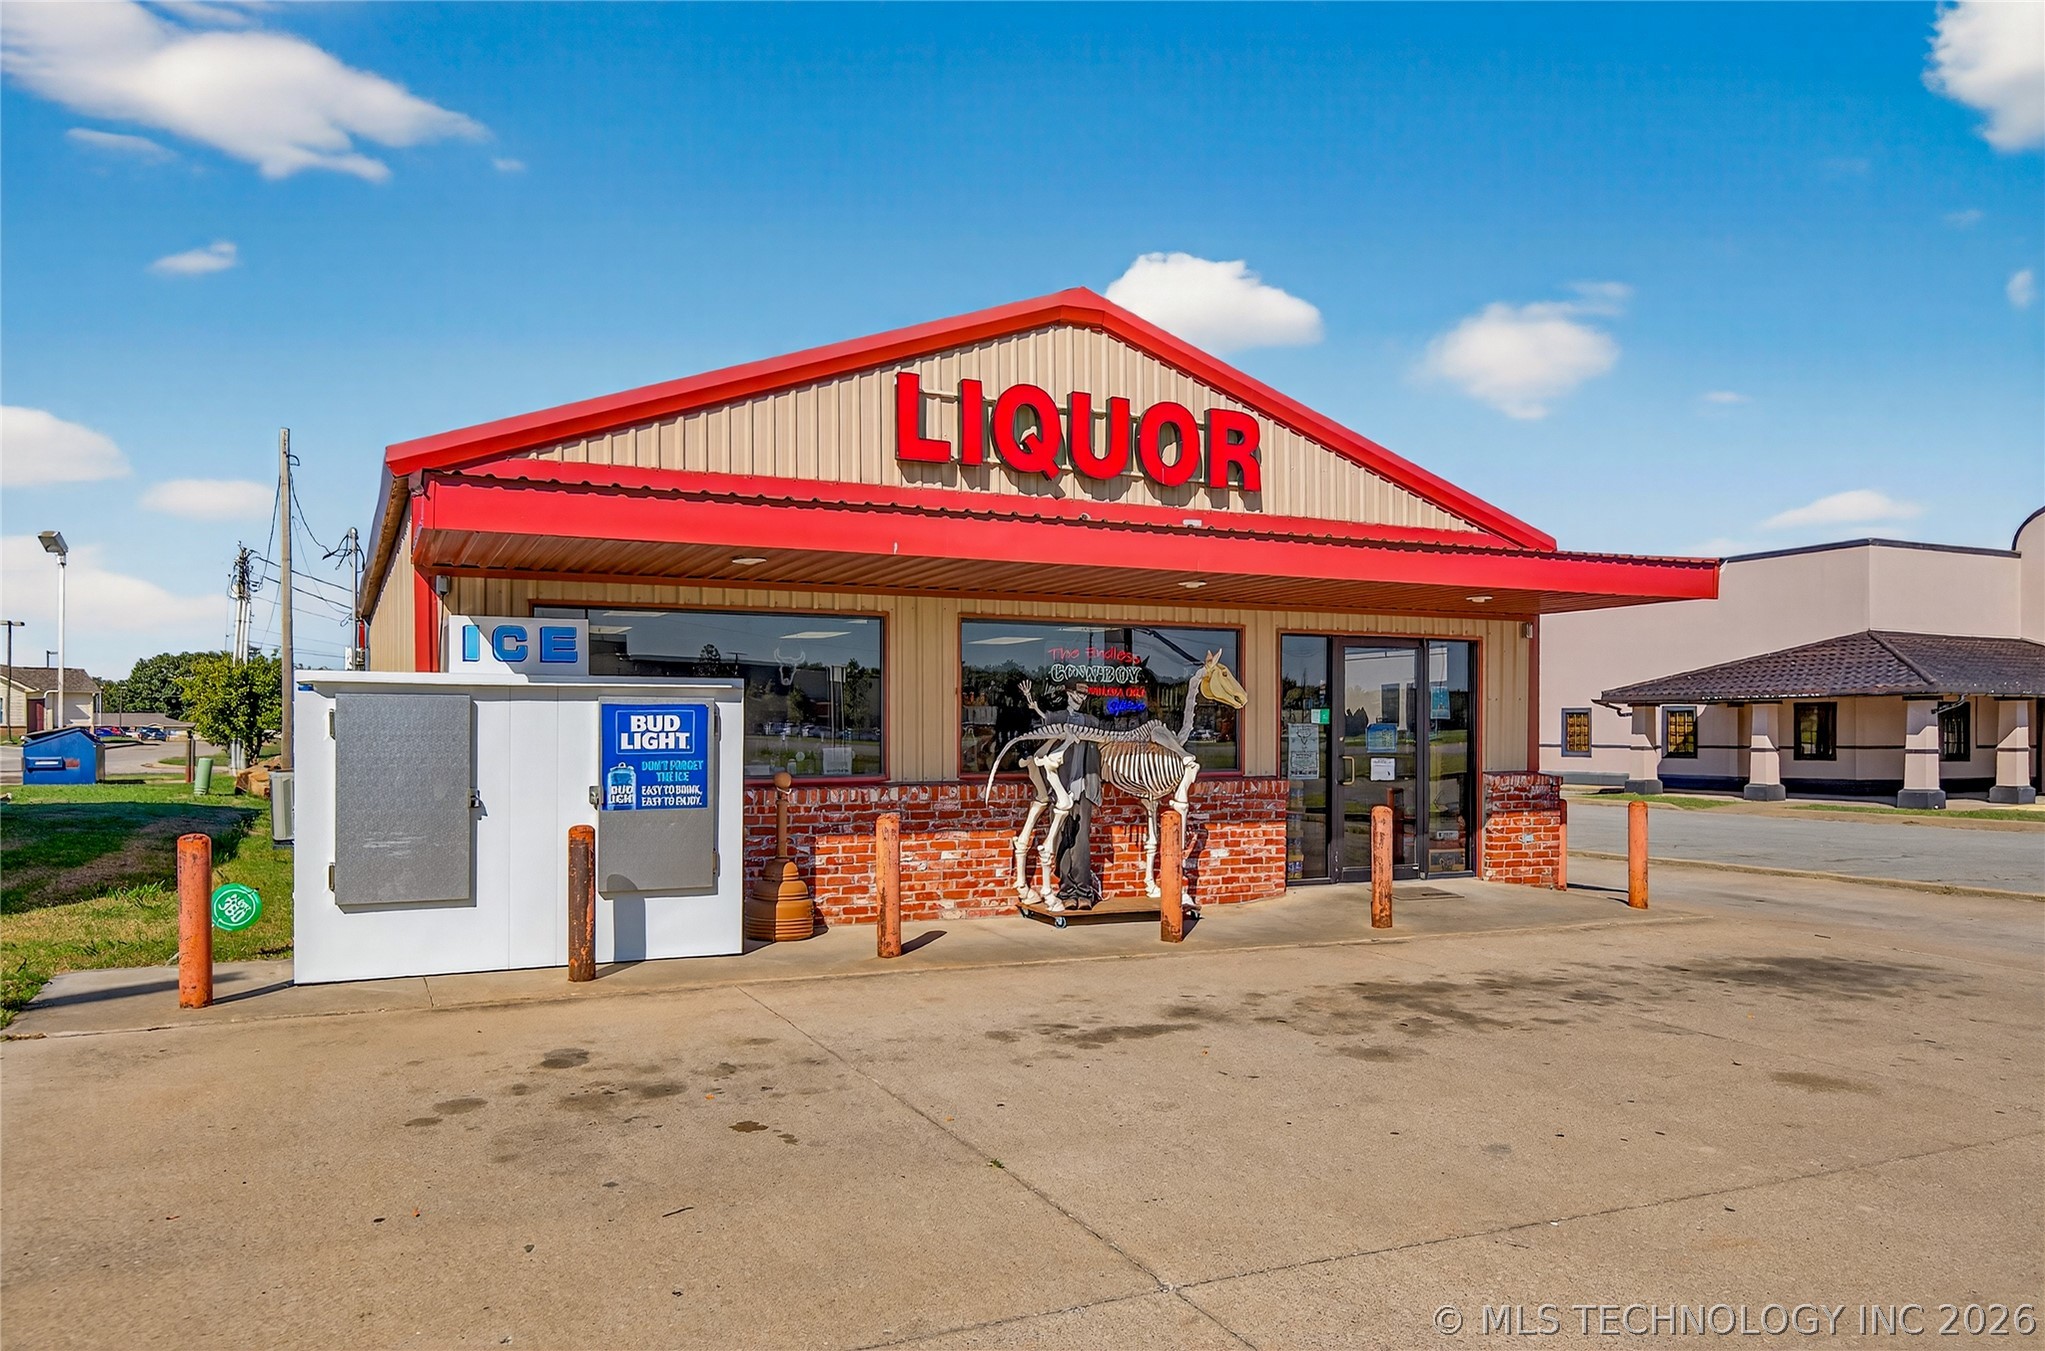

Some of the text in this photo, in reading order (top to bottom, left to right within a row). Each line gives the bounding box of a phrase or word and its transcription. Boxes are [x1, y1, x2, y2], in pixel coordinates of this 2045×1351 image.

[896, 371, 1262, 491] LIQUOR
[462, 624, 578, 663] ICE
[1049, 663, 1143, 684] COWBOY
[630, 715, 681, 732] BUD
[670, 760, 704, 771] FORGET
[656, 771, 690, 782] THE ICE
[641, 785, 662, 795] EASY
[663, 785, 675, 795] TO
[641, 796, 662, 807] EASY
[663, 796, 675, 806] TO
